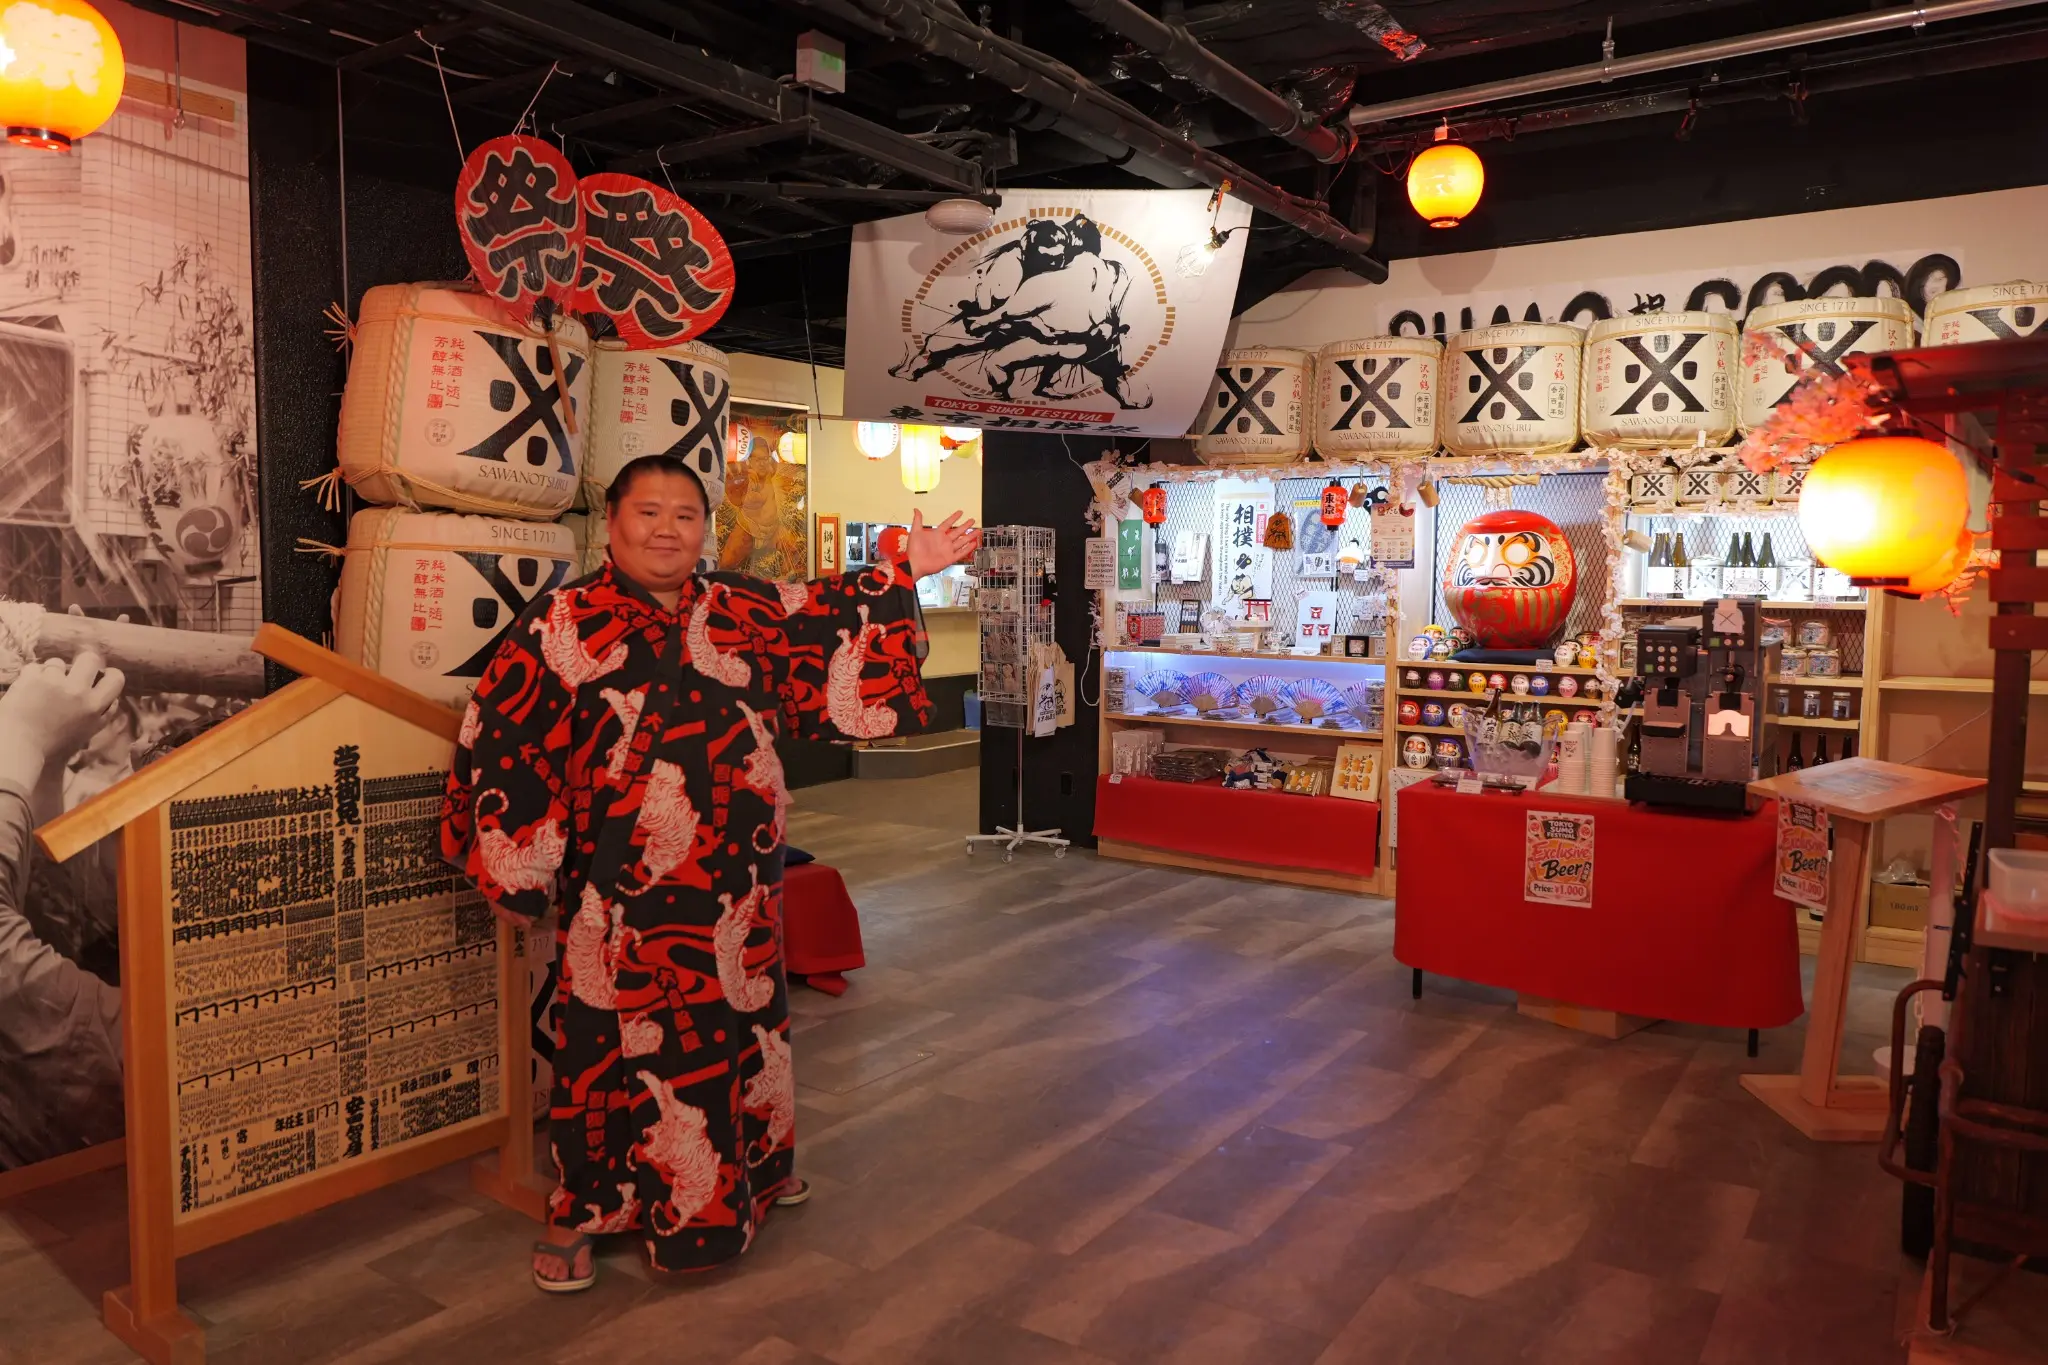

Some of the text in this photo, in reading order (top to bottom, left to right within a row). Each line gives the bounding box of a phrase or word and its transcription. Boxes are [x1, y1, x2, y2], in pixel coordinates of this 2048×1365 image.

[461, 146, 582, 305] 祭
[1993, 285, 2028, 297] SINCE
[1800, 301, 1857, 313] SINCE 1717
[1635, 315, 1688, 327] SINCE 1717
[1479, 328, 1526, 340] SINCE 1717
[1888, 329, 1898, 351] 沢の
[1349, 340, 1393, 351] SINCE 1717
[1226, 351, 1268, 360] SINCE 1717
[933, 398, 1104, 422] TOKYO SUMO FESTIVAL
[1621, 415, 1697, 427] SAWANOTSURU
[1466, 423, 1532, 434] SAWANOTSURU
[1215, 437, 1273, 445] SAWANOTSURU
[1338, 431, 1400, 441] SAWANOTSURU
[477, 463, 569, 493] SAWANOTSURU
[1324, 492, 1335, 515] 東京
[1232, 503, 1255, 549] 相撲
[491, 525, 556, 544] SINCE 1717
[1548, 820, 1574, 828] TOKYO
[1550, 826, 1574, 834] SUMO
[1531, 841, 1590, 862] Exclusive
[1788, 849, 1820, 873] Beer
[1541, 859, 1583, 880] Beer
[1533, 883, 1554, 893] Price:
